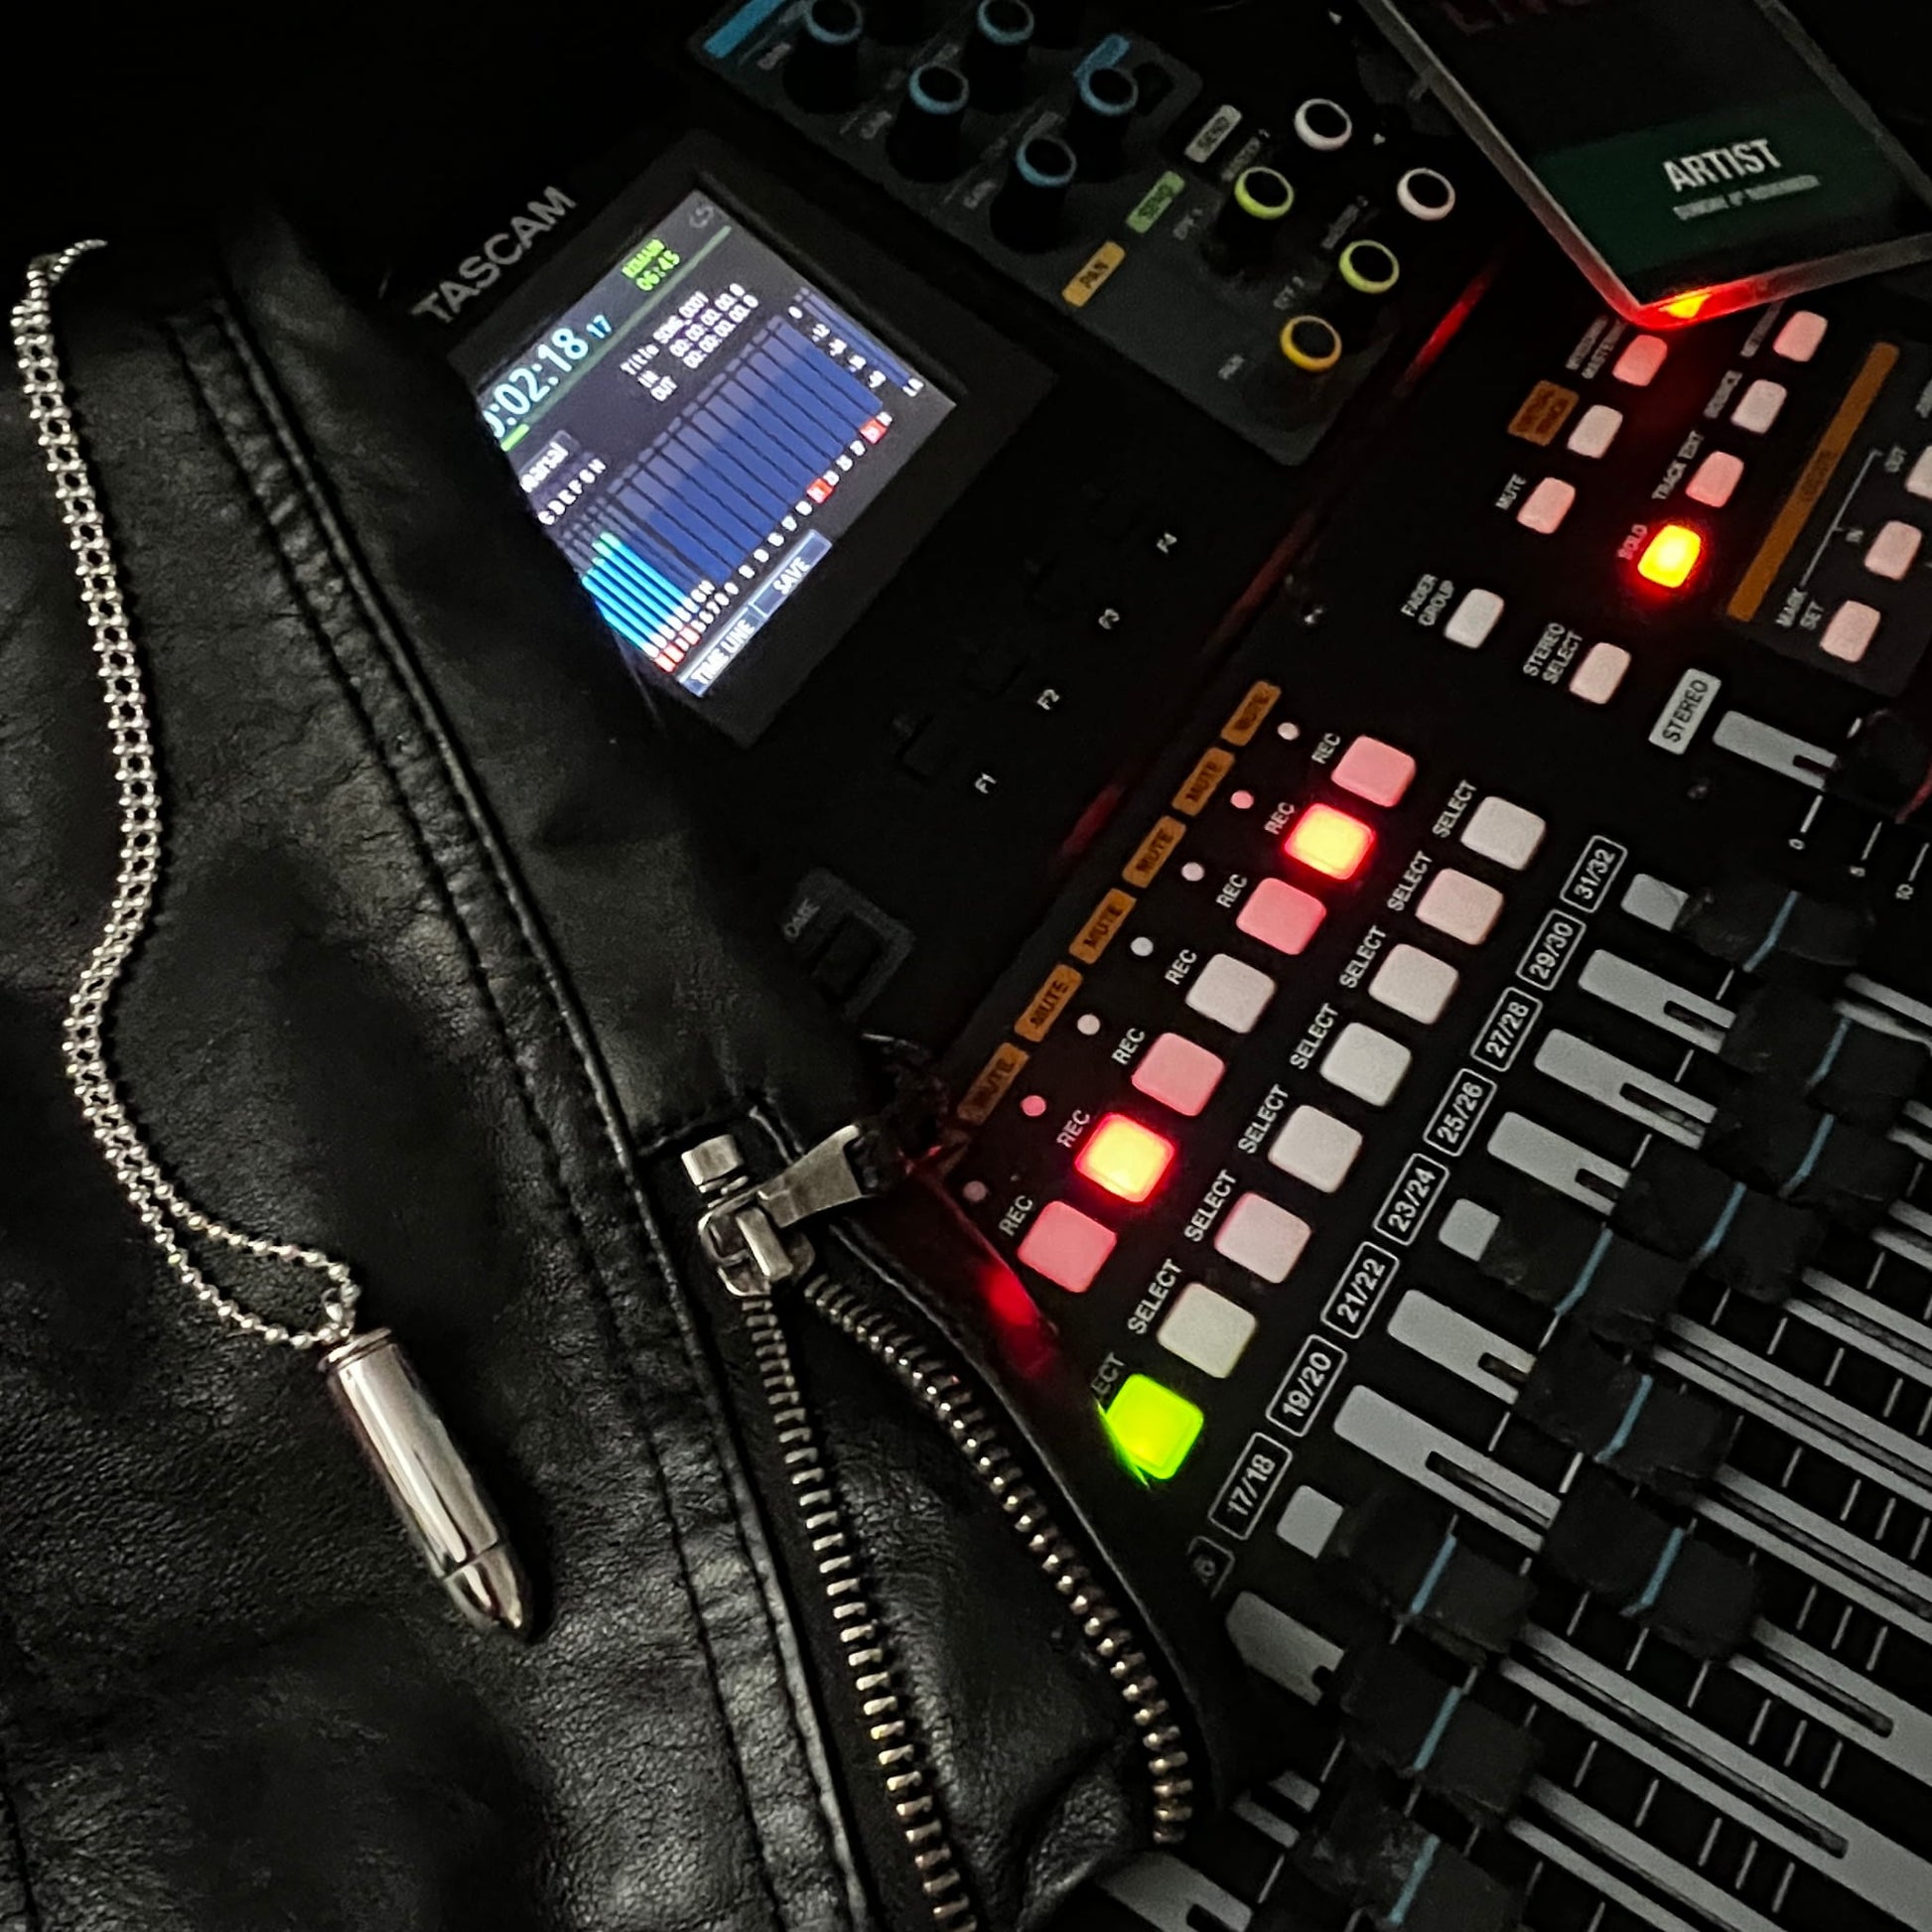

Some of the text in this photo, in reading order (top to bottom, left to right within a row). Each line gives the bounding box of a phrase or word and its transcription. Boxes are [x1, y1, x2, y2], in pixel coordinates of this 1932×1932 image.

[1662, 138, 1782, 192] ARTIST
[406, 185, 578, 324] TASCAM
[636, 250, 680, 291] 06:45
[587, 315, 613, 339] 17
[621, 344, 659, 376] Title
[520, 442, 569, 493] earsal
[1652, 454, 1687, 500] TRACK
[1617, 523, 1649, 560] SOLO
[773, 557, 811, 596] SAVE
[1401, 572, 1438, 619] FADER
[1418, 580, 1455, 626] GROUP
[1800, 601, 1824, 630] SET
[690, 647, 729, 686] TIME
[720, 618, 756, 654] LINE
[1523, 622, 1567, 677] STEREO
[1542, 631, 1583, 684] SELECT
[1036, 688, 1061, 712] F2
[1663, 680, 1708, 743] STEREO
[1311, 733, 1341, 764] REC
[974, 771, 998, 794] F1
[1264, 801, 1295, 835] REC
[1432, 779, 1477, 839] SELECT
[1137, 830, 1175, 872] MUTE
[1789, 839, 1805, 851] 0
[1215, 875, 1247, 908] REC
[1388, 851, 1433, 912] SELECT
[1575, 847, 1615, 900] 31/32
[1850, 865, 1866, 879] 5
[1894, 883, 1914, 901] 10
[1084, 902, 1123, 948] MUTE
[1165, 949, 1197, 986] REC
[1340, 926, 1387, 989] SELECT
[1530, 921, 1574, 978] 29/30
[1031, 980, 1069, 1028] MUTE
[1111, 1028, 1147, 1066] REC
[1289, 1002, 1339, 1070] SELECT
[1486, 1002, 1529, 1059] 27/28
[1056, 1109, 1092, 1148] REC
[1238, 1084, 1289, 1156] SELECT
[1437, 1082, 1484, 1143] 25/26
[998, 1194, 1035, 1237] REC
[1183, 1170, 1238, 1243] SELECT
[1388, 1169, 1437, 1233] 23/24
[1127, 1258, 1183, 1335] SELECT
[1336, 1258, 1386, 1325] 21/22
[1091, 1352, 1129, 1400] ECT
[1282, 1351, 1333, 1419] 19/20
[1227, 1453, 1277, 1518] 17/18
